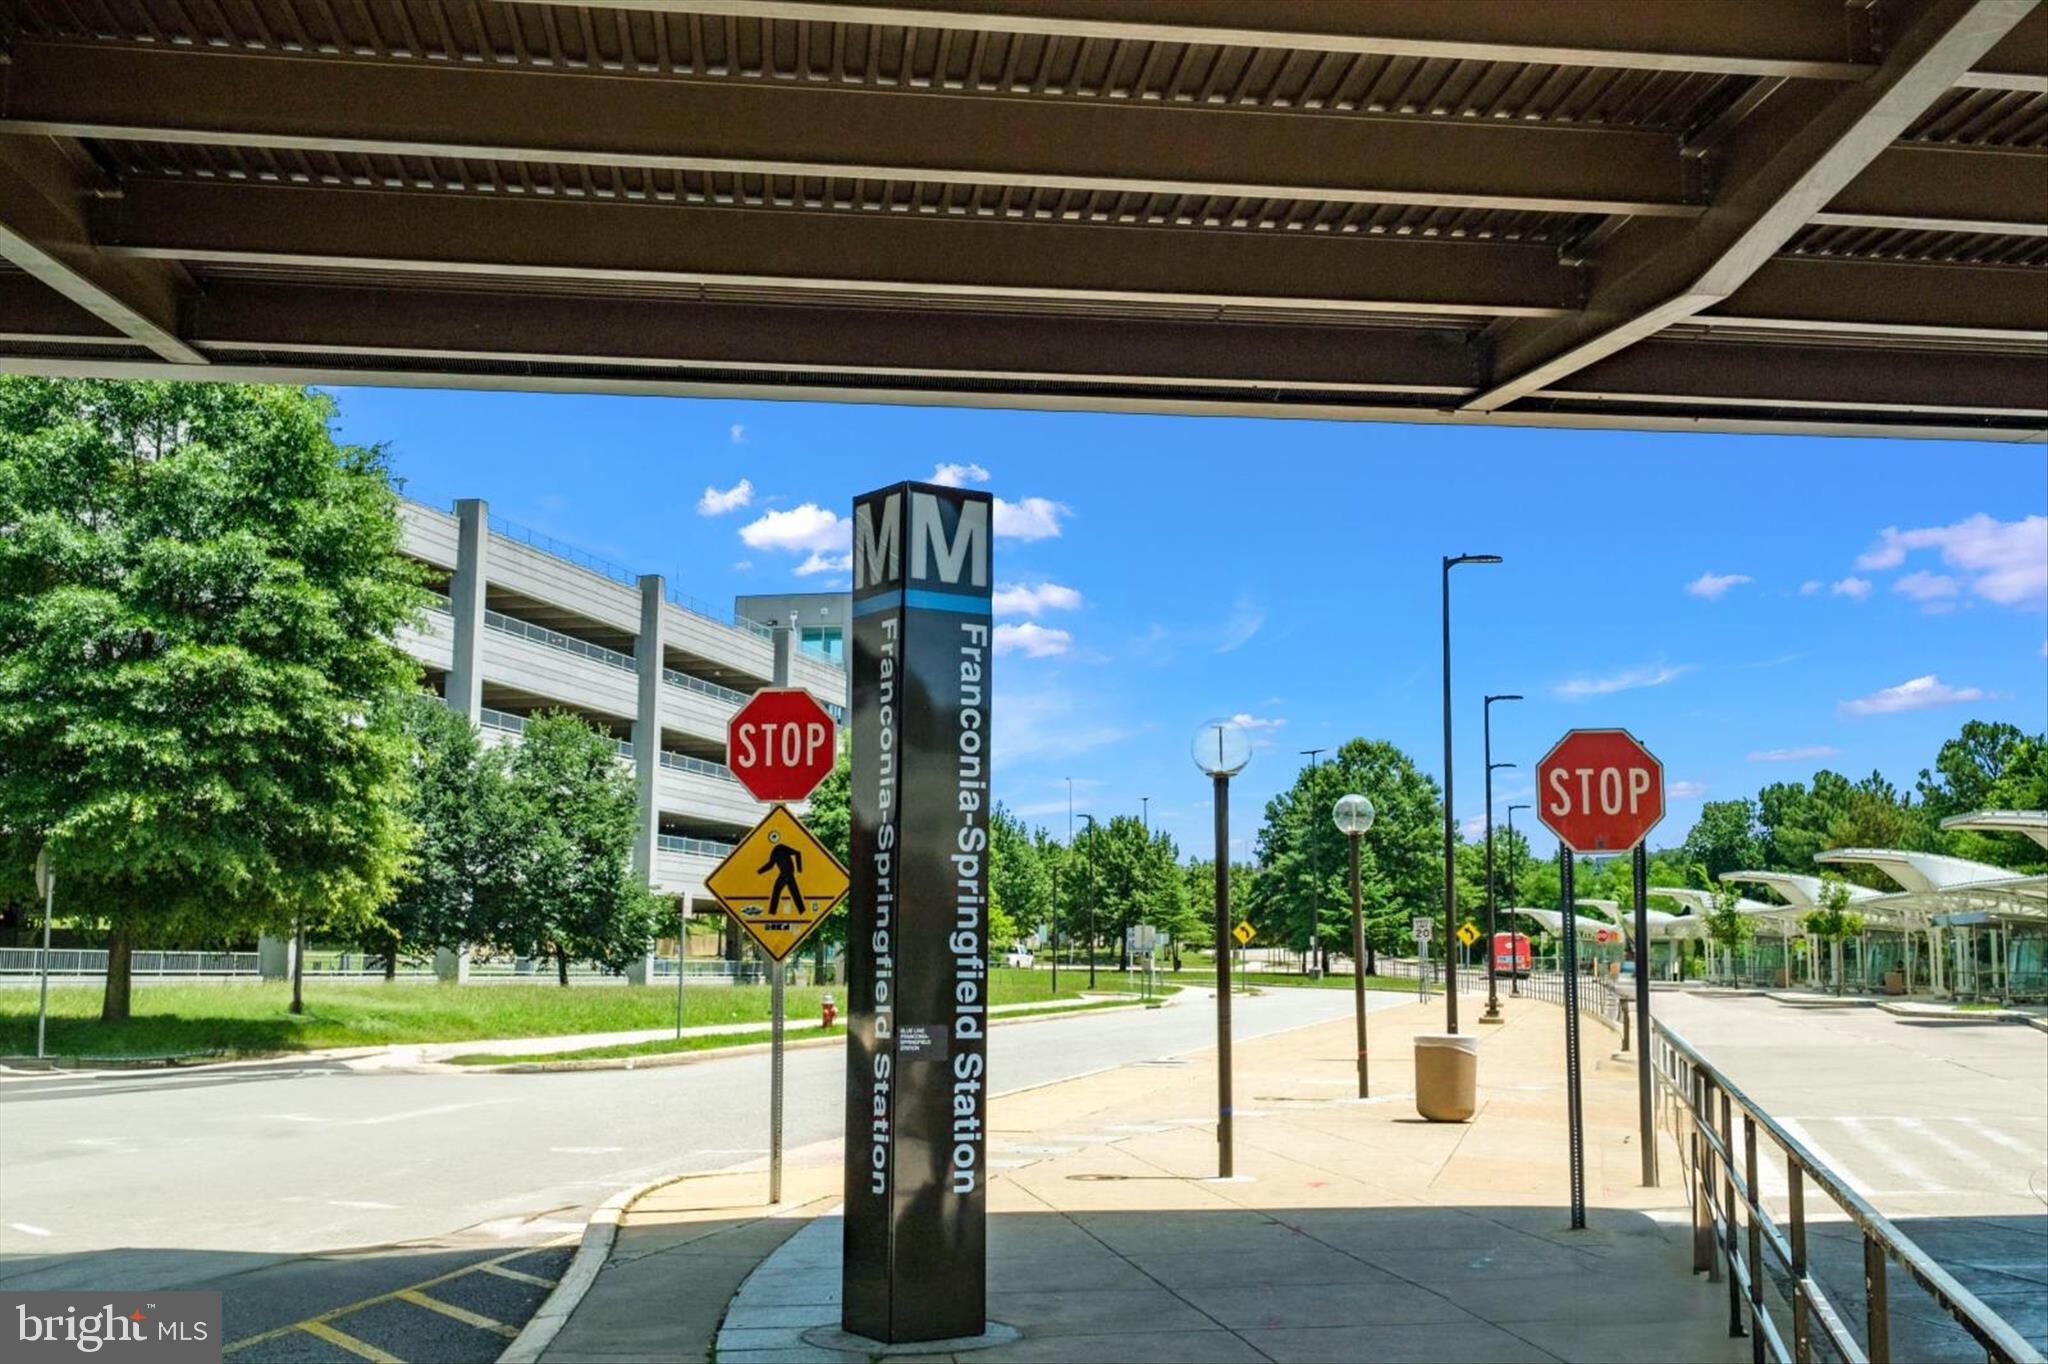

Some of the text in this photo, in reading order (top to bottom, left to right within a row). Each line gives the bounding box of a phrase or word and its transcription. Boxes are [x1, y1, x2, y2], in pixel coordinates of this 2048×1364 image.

[855, 492, 901, 589] M
[911, 492, 987, 587] M
[738, 723, 825, 768] STOP
[1549, 767, 1650, 816] STOP
[872, 617, 898, 1195] Franconia-Springfield Station
[950, 622, 987, 1193] Franconia-Springfield Station
[1415, 928, 1429, 938] 20
